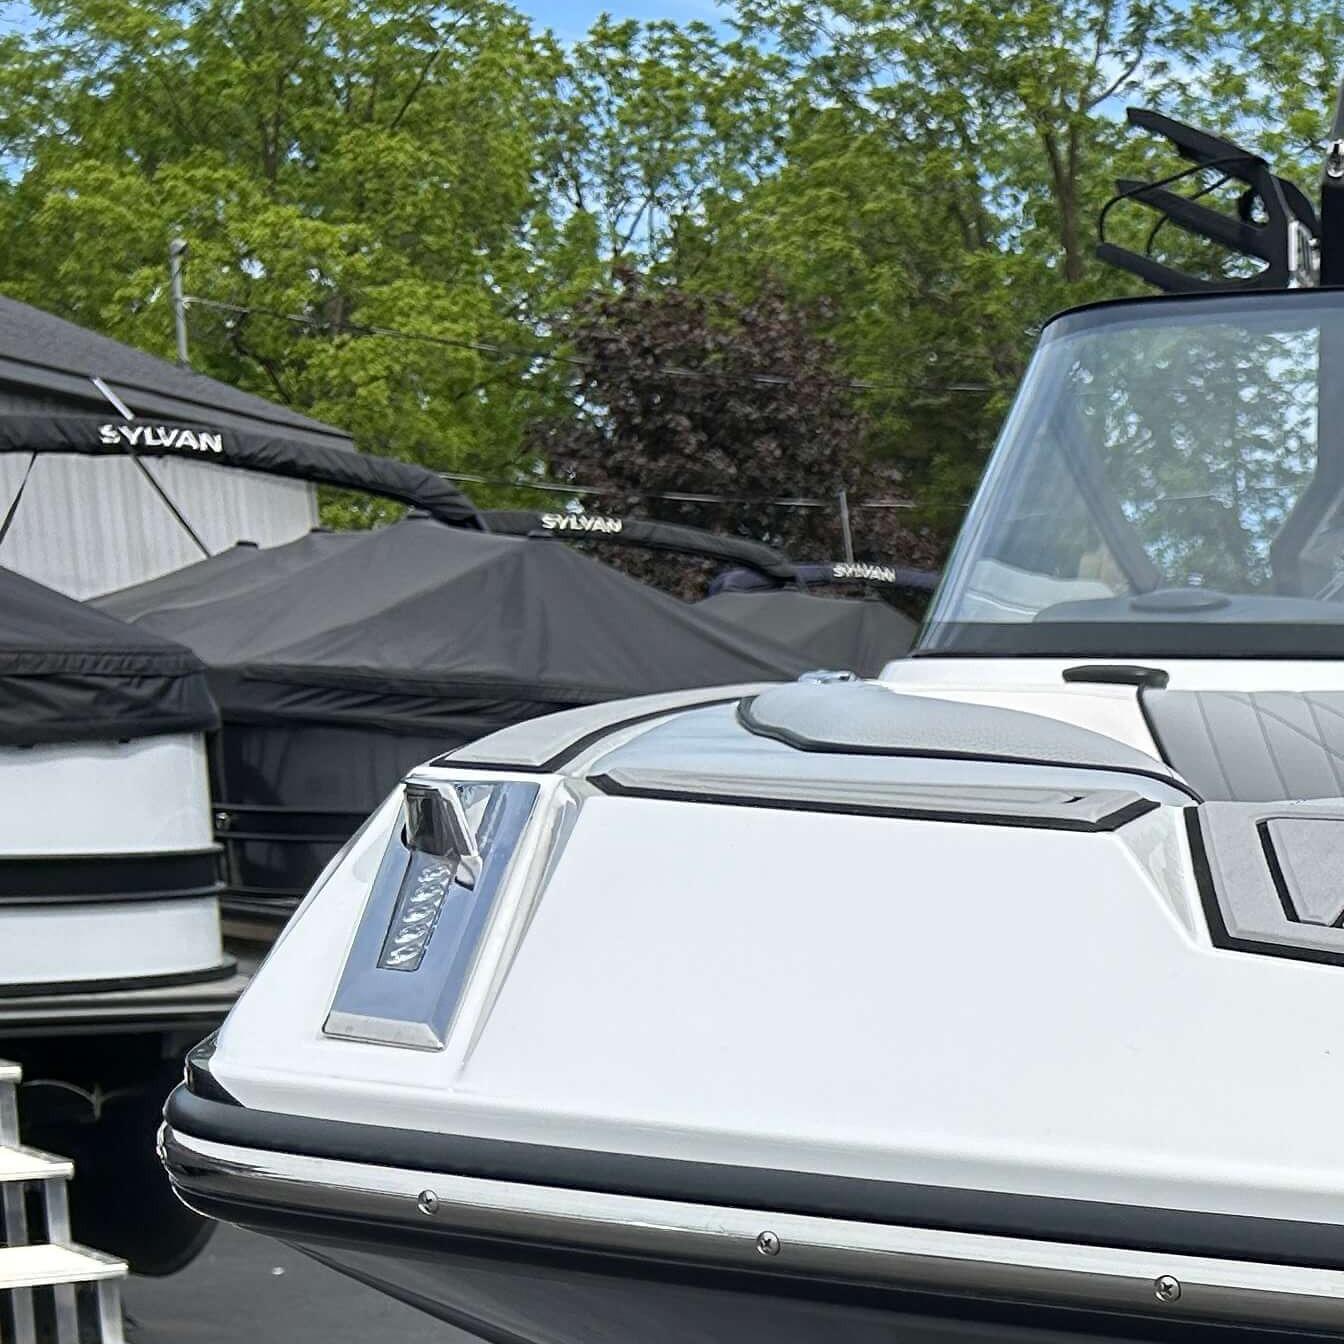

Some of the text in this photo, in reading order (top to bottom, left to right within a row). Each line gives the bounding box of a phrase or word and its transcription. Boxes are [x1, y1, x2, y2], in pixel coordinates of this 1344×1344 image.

[99, 424, 222, 453] SYLVAN
[542, 513, 622, 533] SYLVAN
[833, 562, 896, 582] SYLVAN
